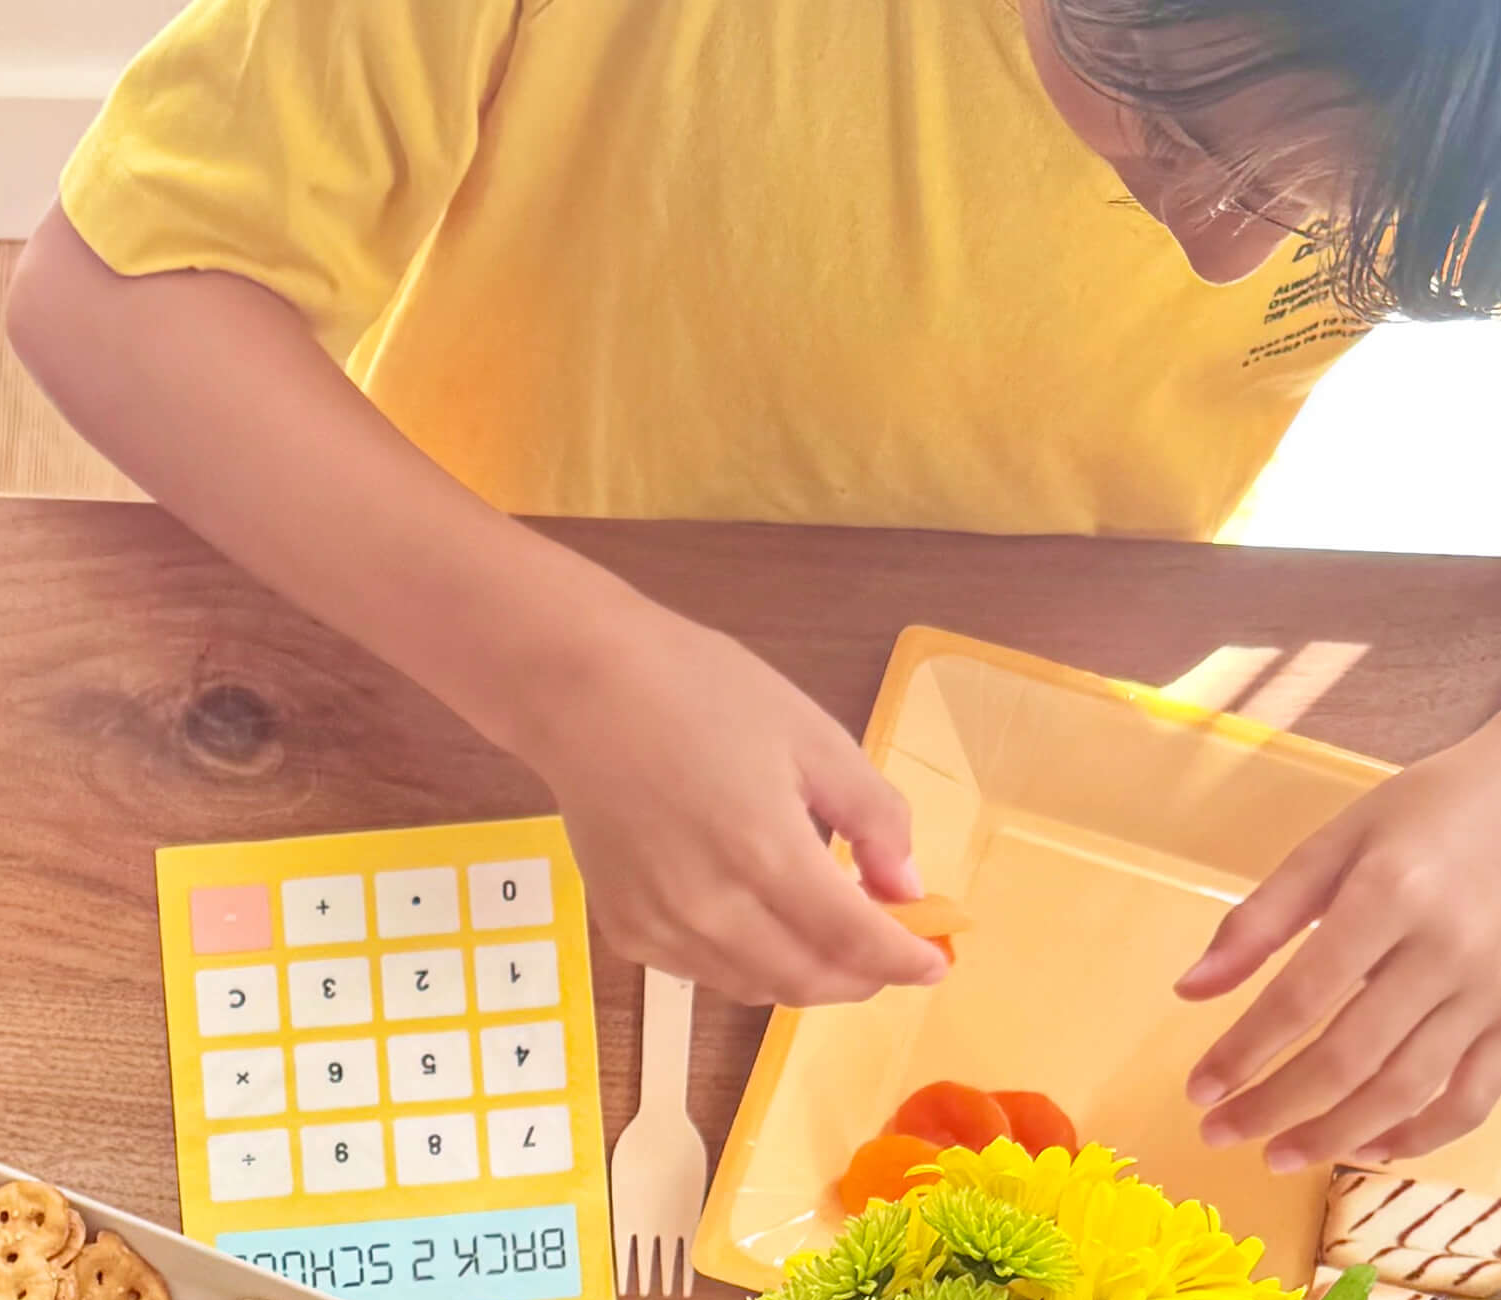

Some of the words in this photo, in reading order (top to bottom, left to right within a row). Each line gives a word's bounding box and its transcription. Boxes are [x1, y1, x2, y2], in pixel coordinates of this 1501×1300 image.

[415, 969, 430, 991] 2
[510, 962, 521, 983] 1
[322, 978, 336, 999] 3
[421, 1053, 437, 1075] 5
[515, 1045, 530, 1067] 4
[328, 1062, 343, 1083] 6
[427, 1134, 442, 1156] 8
[523, 1125, 536, 1148] 7
[334, 1142, 349, 1163] 9
[412, 1240, 435, 1281] 2
[454, 1227, 567, 1277] BACK
